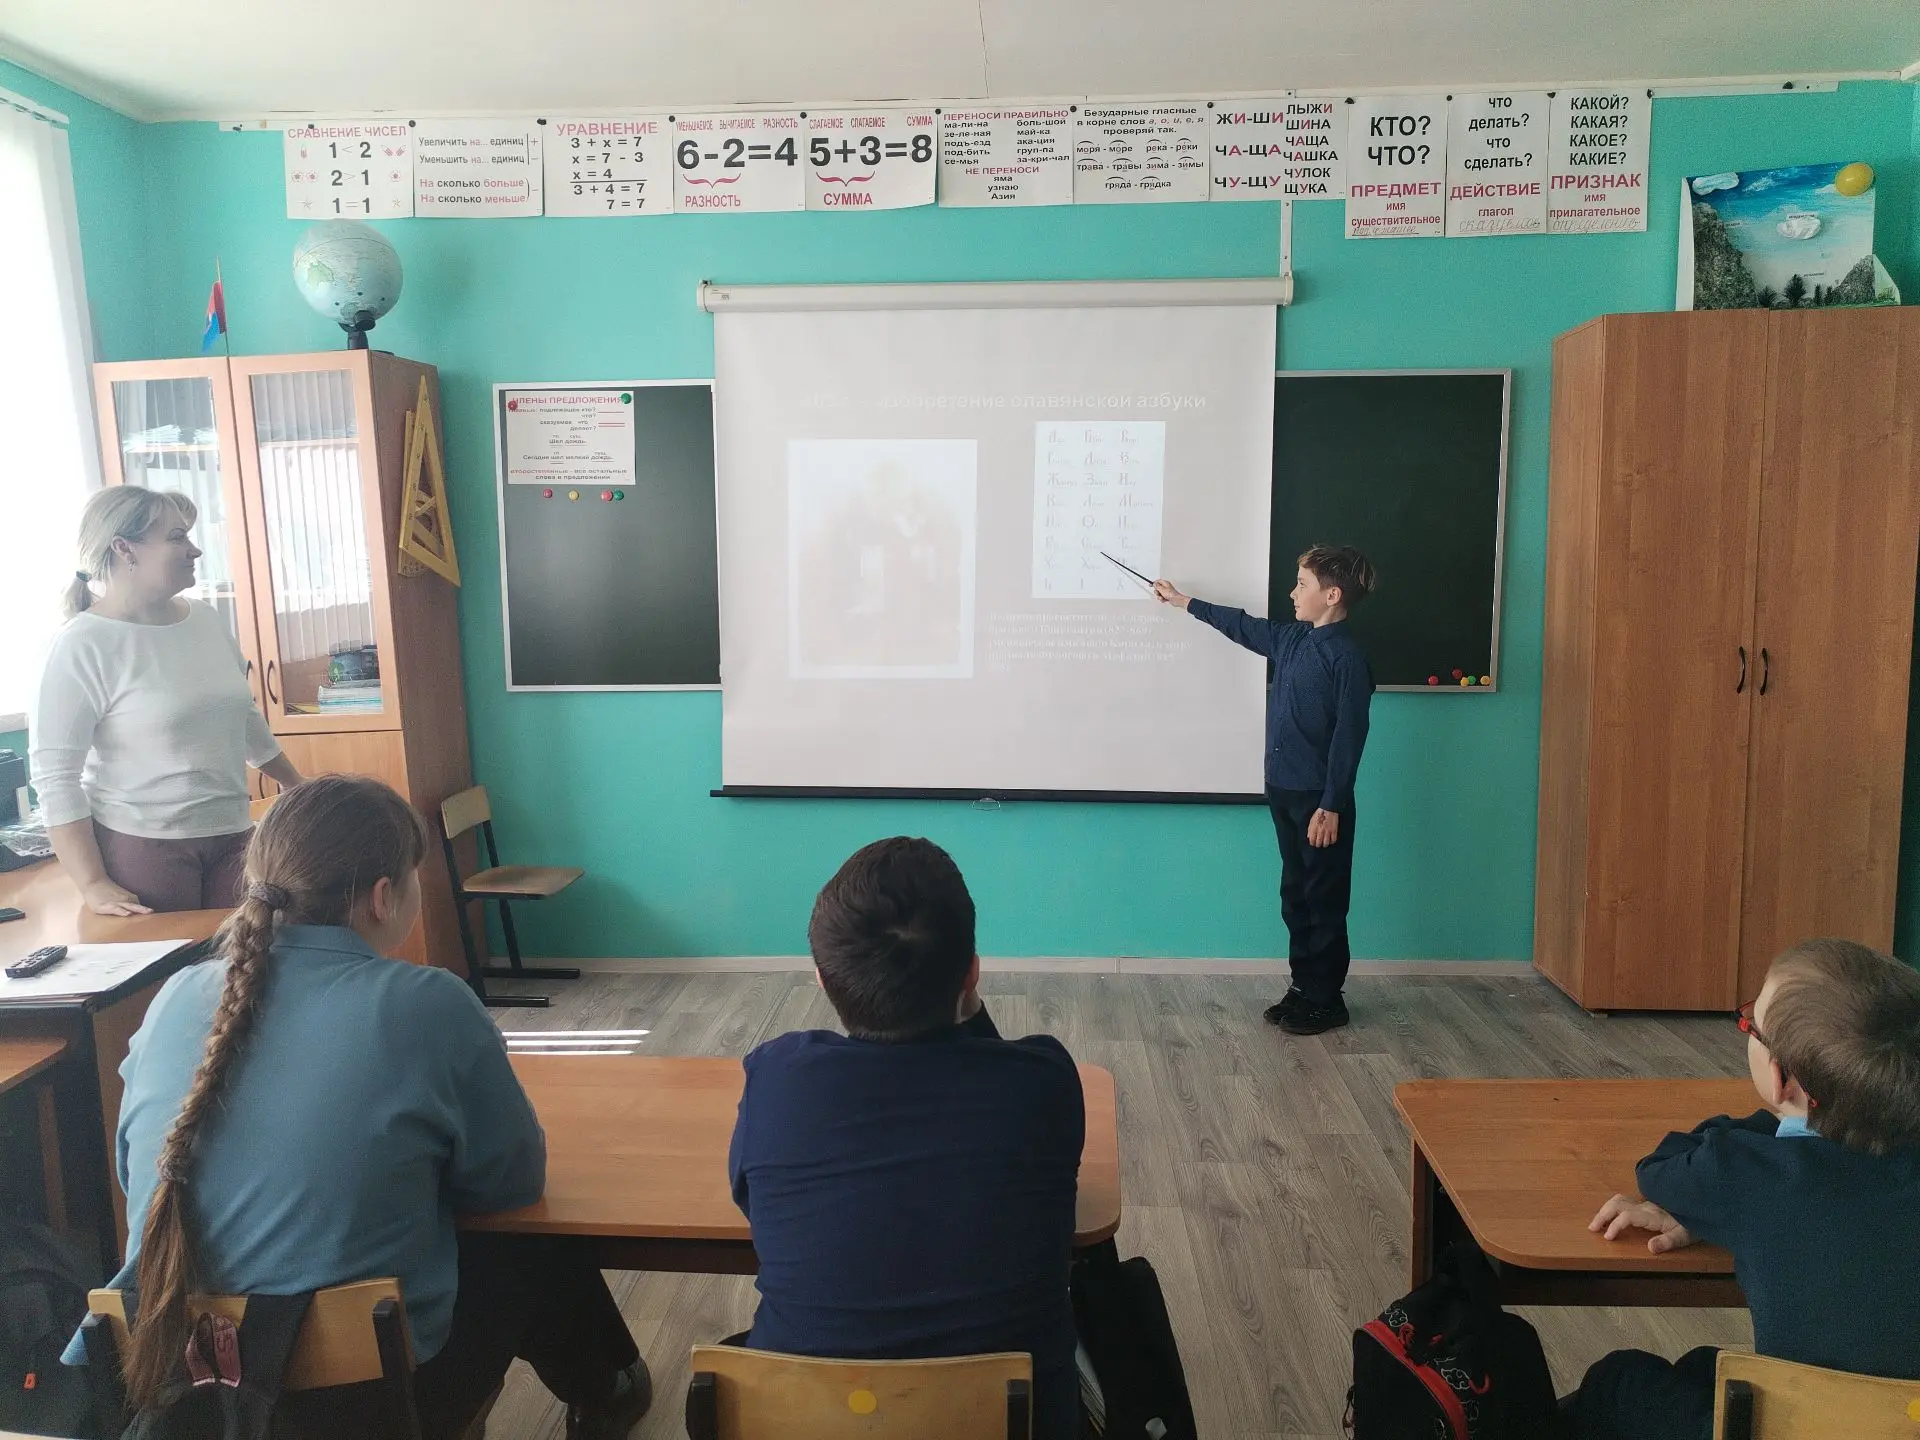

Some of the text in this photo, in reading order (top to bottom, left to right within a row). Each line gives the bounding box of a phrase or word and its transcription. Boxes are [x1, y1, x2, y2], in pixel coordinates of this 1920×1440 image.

[1488, 97, 1512, 108] что
[1570, 94, 1629, 110] КАКОЙ?
[944, 110, 1068, 120] ПЕРЕНОСИ ПРАВИЛЬНО
[1084, 109, 1148, 117] Безударные
[1286, 104, 1332, 114] ЛЫЖИ
[763, 118, 798, 128] РАЗНОСТЬ
[809, 116, 933, 130] СЛАГАЕМОЕ СЛАГАЕМОЕ СУММА
[1016, 118, 1066, 126] боль-шой
[1086, 119, 1116, 127] корне
[1216, 112, 1284, 124] ЖИ-ШИ
[1468, 113, 1530, 132] делать?
[1570, 115, 1628, 128] КАКАЯ?
[557, 122, 658, 136] УРАВНЕНИЕ
[1286, 119, 1331, 130] ШИНА
[1370, 115, 1431, 136] КТО?
[288, 126, 407, 138] СРАВНЕНИЕ ЧИСЕЛ
[1104, 126, 1154, 136] проверяй
[418, 138, 467, 146] Увеличить
[490, 138, 524, 147] единиц
[571, 138, 580, 148] 3
[634, 136, 642, 147] 7
[944, 140, 991, 148] подъ-езд
[1286, 136, 1329, 148] ЧАЩА
[1486, 138, 1510, 148] что
[1570, 134, 1628, 147] КАКОЕ?
[329, 142, 337, 158] 1
[360, 142, 372, 158] 2
[1017, 147, 1054, 156] груп-па
[1216, 144, 1281, 157] ЧА-ЩА
[1283, 150, 1338, 162] ЧАШКА
[1368, 144, 1430, 166] ЧТО?
[420, 155, 468, 164] Уменьшить
[492, 156, 525, 164] единиц
[602, 152, 610, 164] 7
[634, 152, 644, 162] 3
[1016, 155, 1070, 164] за-кри-чал
[1464, 153, 1532, 171] сделать?
[1570, 152, 1626, 166] КАКИЕ?
[603, 168, 612, 178] 4
[982, 166, 1040, 174] ПЕРЕНОСИ
[1284, 168, 1332, 178] ЧУЛОК
[331, 170, 343, 186] 2
[361, 170, 369, 186] 1
[420, 178, 434, 188] На
[484, 178, 524, 188] больше
[1214, 176, 1281, 188] ЧУ-ЩУ
[1550, 173, 1642, 190] ПРИЗНАК
[574, 184, 582, 195] 3
[605, 184, 614, 194] 4
[636, 183, 645, 194] 7
[1284, 183, 1328, 196] ЩУКА
[1351, 182, 1442, 198] ПРЕДМЕТ
[1450, 182, 1540, 200] ДЕЙСТВИЕ
[420, 194, 526, 204] На сколько меньше
[606, 200, 614, 210] 7
[636, 198, 645, 208] 7
[685, 195, 741, 208] РАЗНОСТЬ
[824, 193, 872, 206] СУММА
[1584, 194, 1606, 202] имя
[332, 198, 340, 214] 1
[362, 198, 370, 214] 1
[1386, 202, 1406, 211] имя
[1478, 208, 1514, 216] глагол
[1550, 207, 1640, 219] прилагательное
[1352, 216, 1440, 228] существительное
